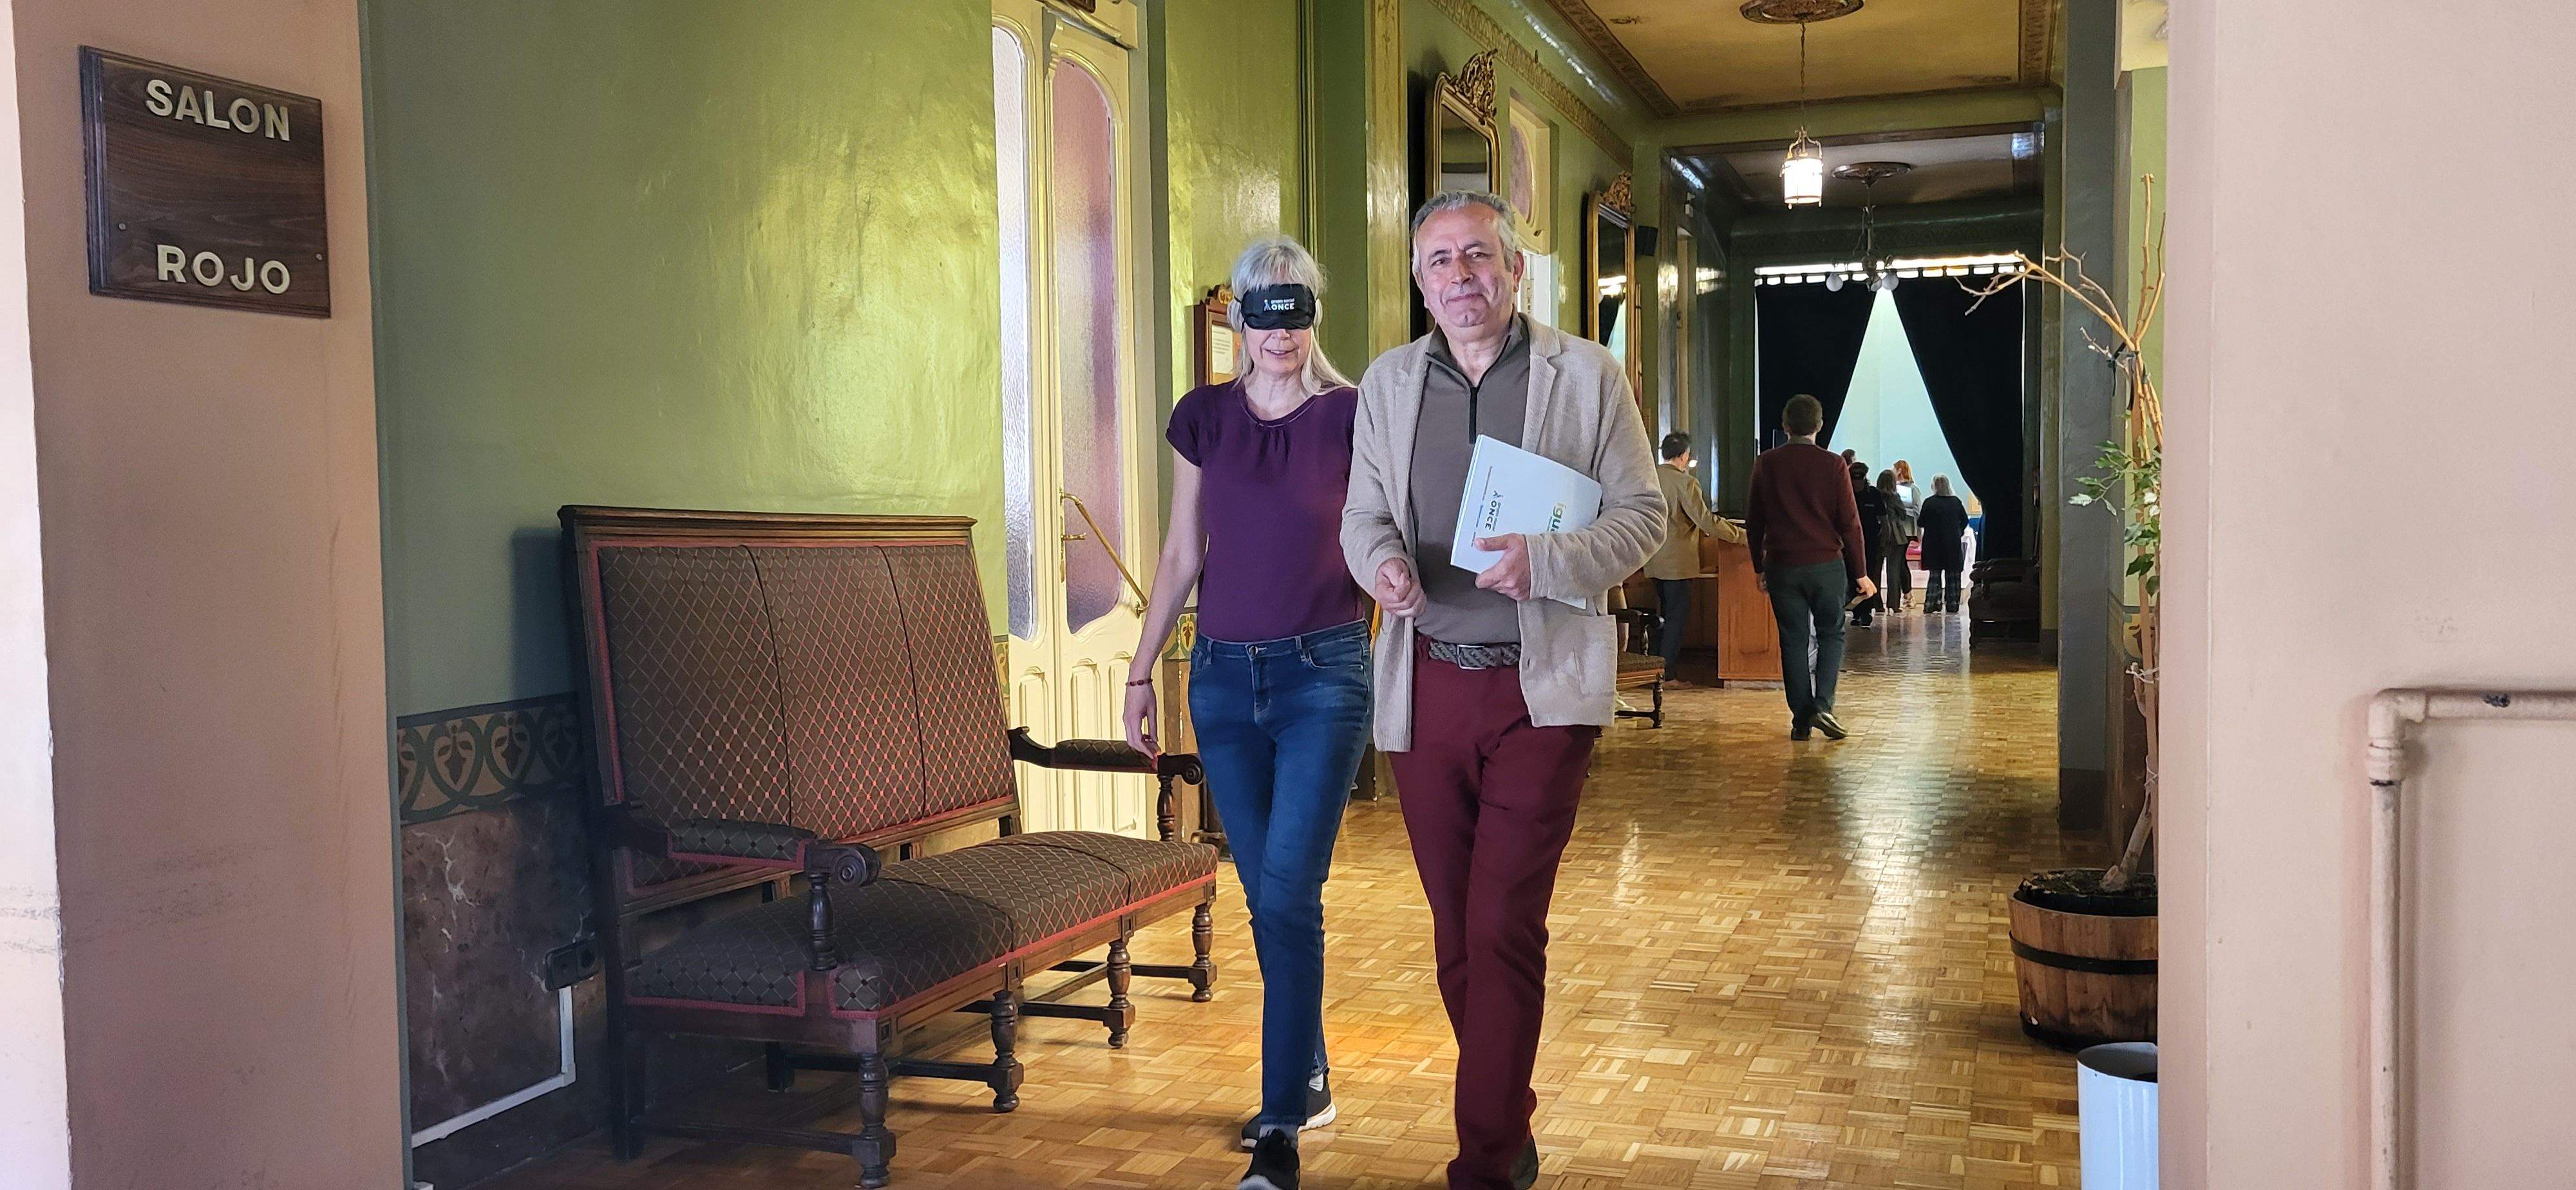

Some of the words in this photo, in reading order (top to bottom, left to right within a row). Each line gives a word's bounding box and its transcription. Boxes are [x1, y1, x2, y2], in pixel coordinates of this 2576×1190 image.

[146, 79, 290, 142] SALON
[156, 244, 290, 294] ROJO
[1485, 500, 1497, 530] ONCE
